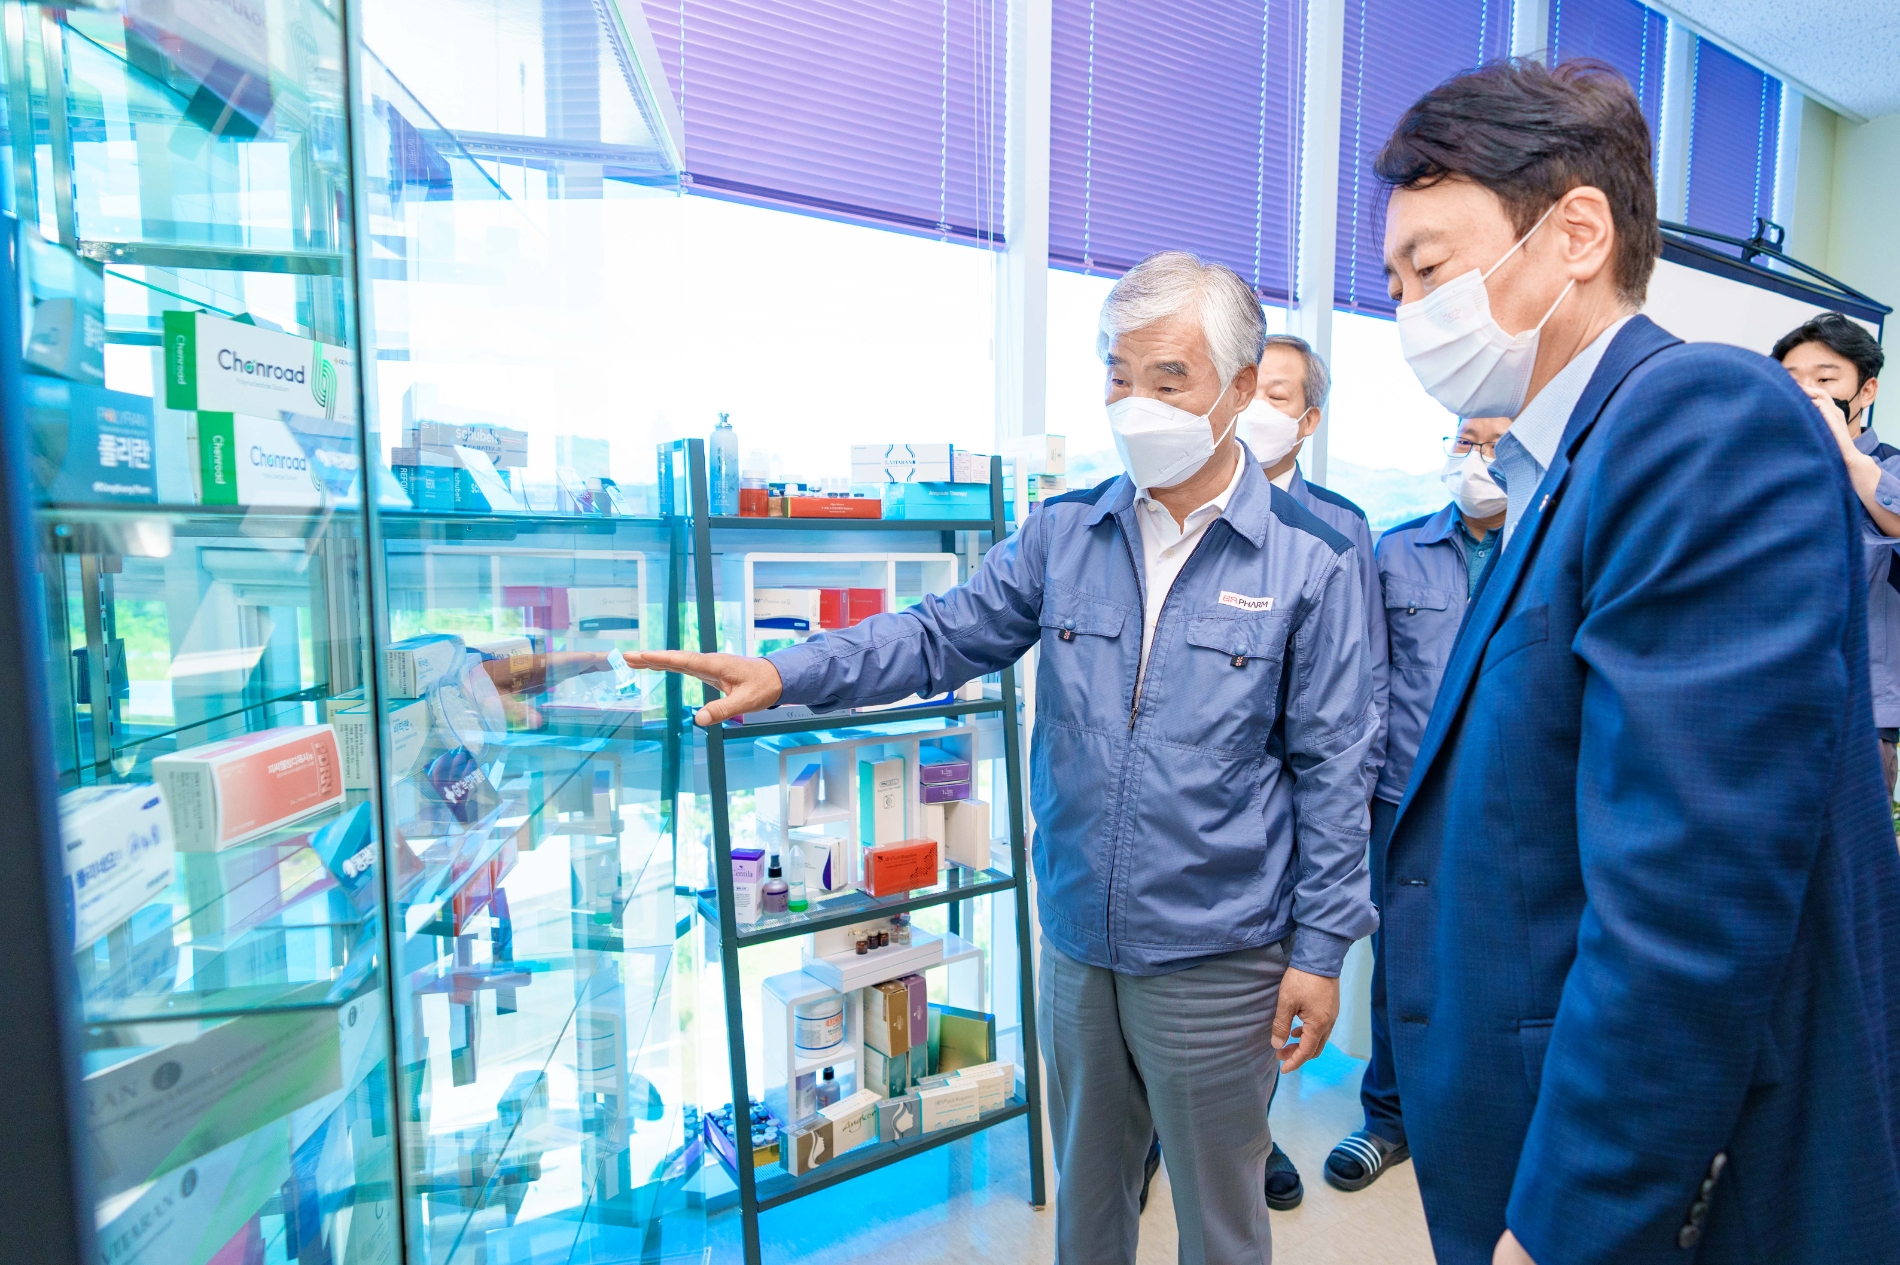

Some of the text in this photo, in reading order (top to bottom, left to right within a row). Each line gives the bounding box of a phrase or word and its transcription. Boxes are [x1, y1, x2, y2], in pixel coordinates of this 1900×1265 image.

[1238, 598, 1269, 609] PHARM
[315, 741, 333, 795] PDRN
[842, 1109, 877, 1134] Angkor
